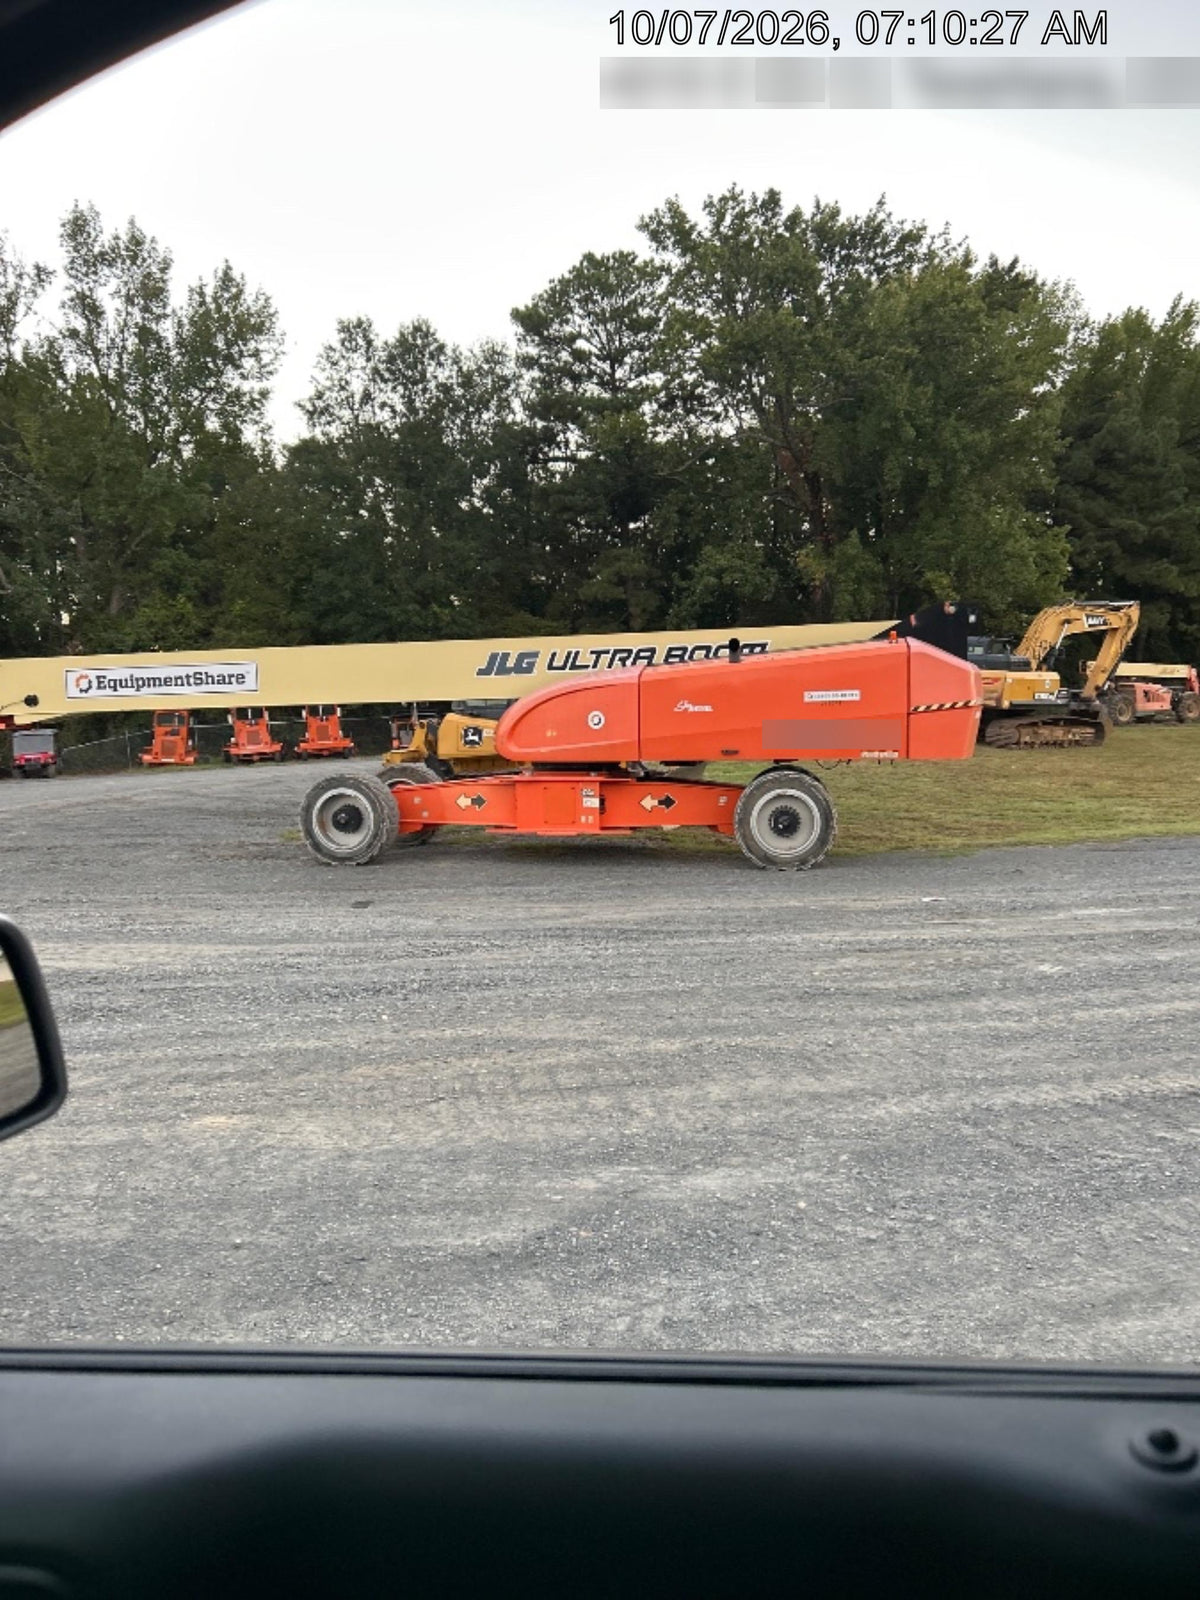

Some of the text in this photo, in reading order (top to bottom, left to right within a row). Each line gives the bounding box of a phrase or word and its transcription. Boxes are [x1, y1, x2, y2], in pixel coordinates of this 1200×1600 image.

[476, 650, 541, 676] JLG
[546, 647, 657, 670] ULTRA
[95, 671, 246, 692] EquipmentShare
